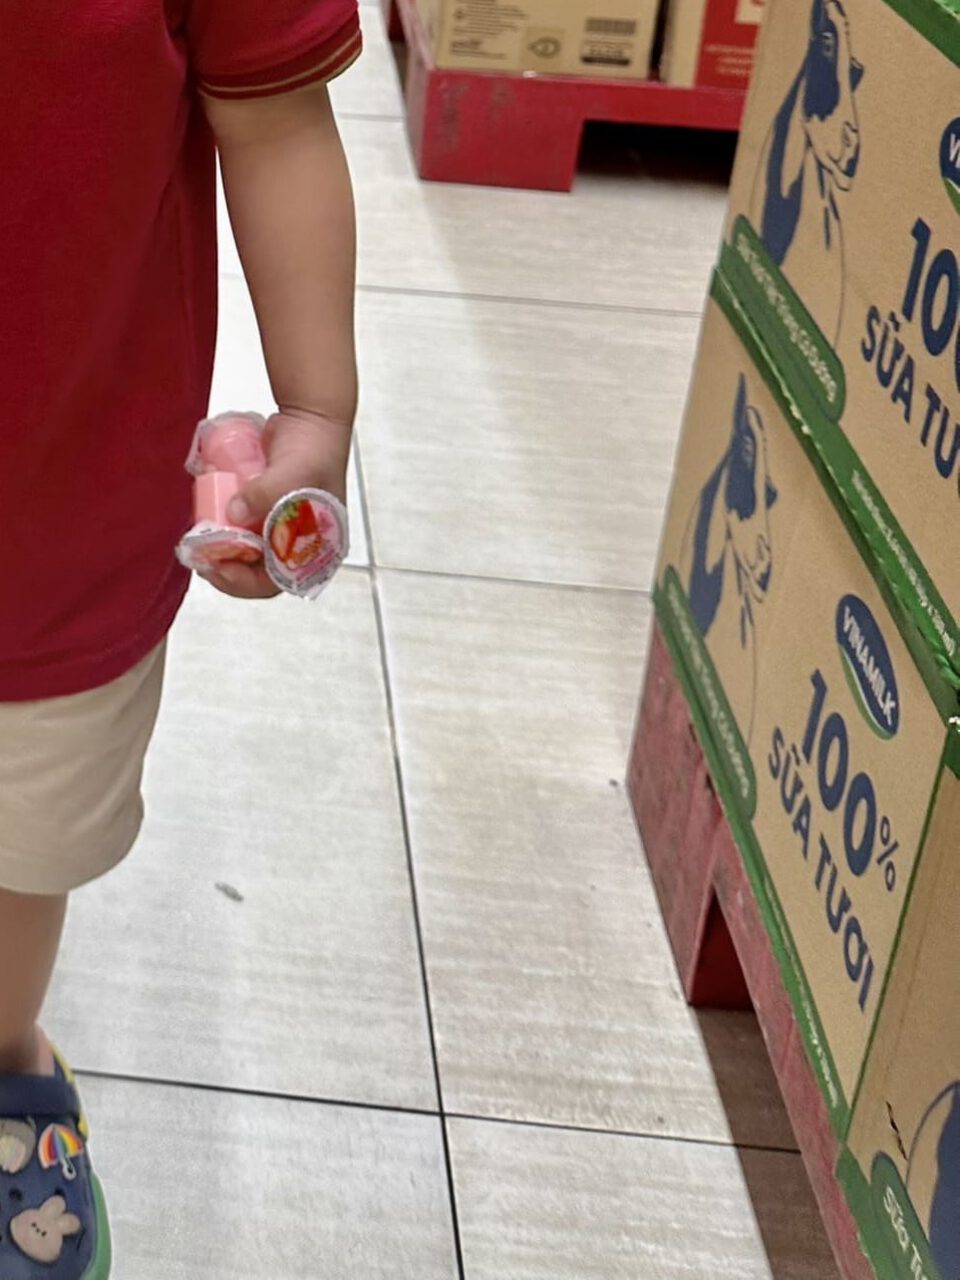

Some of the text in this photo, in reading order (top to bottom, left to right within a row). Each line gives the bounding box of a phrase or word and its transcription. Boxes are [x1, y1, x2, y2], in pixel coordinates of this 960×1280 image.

[861, 305, 915, 424] SỮA
[843, 606, 897, 725] VINAMILK
[801, 668, 900, 892] 100%
[768, 726, 811, 860] SỮA
[815, 832, 874, 1013] TƯƠI
